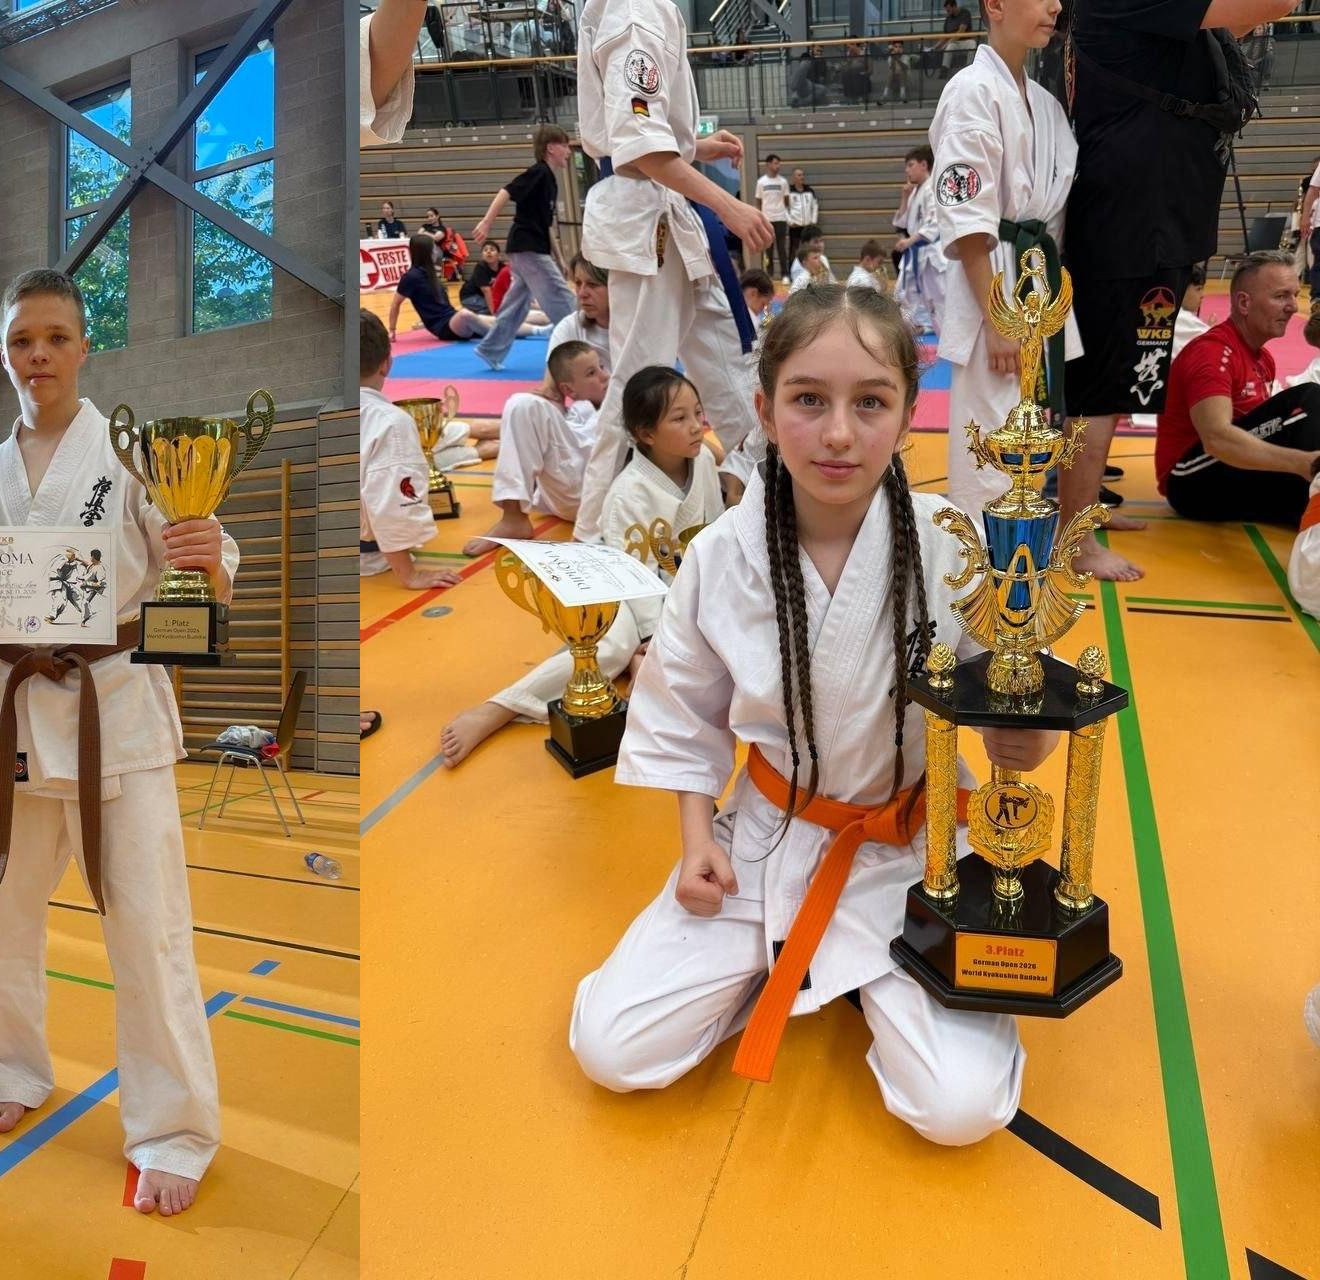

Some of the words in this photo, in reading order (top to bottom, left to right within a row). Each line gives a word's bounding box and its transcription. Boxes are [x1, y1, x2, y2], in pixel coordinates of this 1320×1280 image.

[377, 250, 408, 265] ERSTE
[1136, 329, 1171, 339] WKB
[171, 619, 190, 627] Platz
[972, 958, 1000, 967] German
[1000, 960, 1019, 968] Open
[1019, 962, 1037, 970] 2026
[961, 968, 982, 977] World
[983, 970, 1019, 980] Kyokushin
[1019, 974, 1048, 982] Budokai
